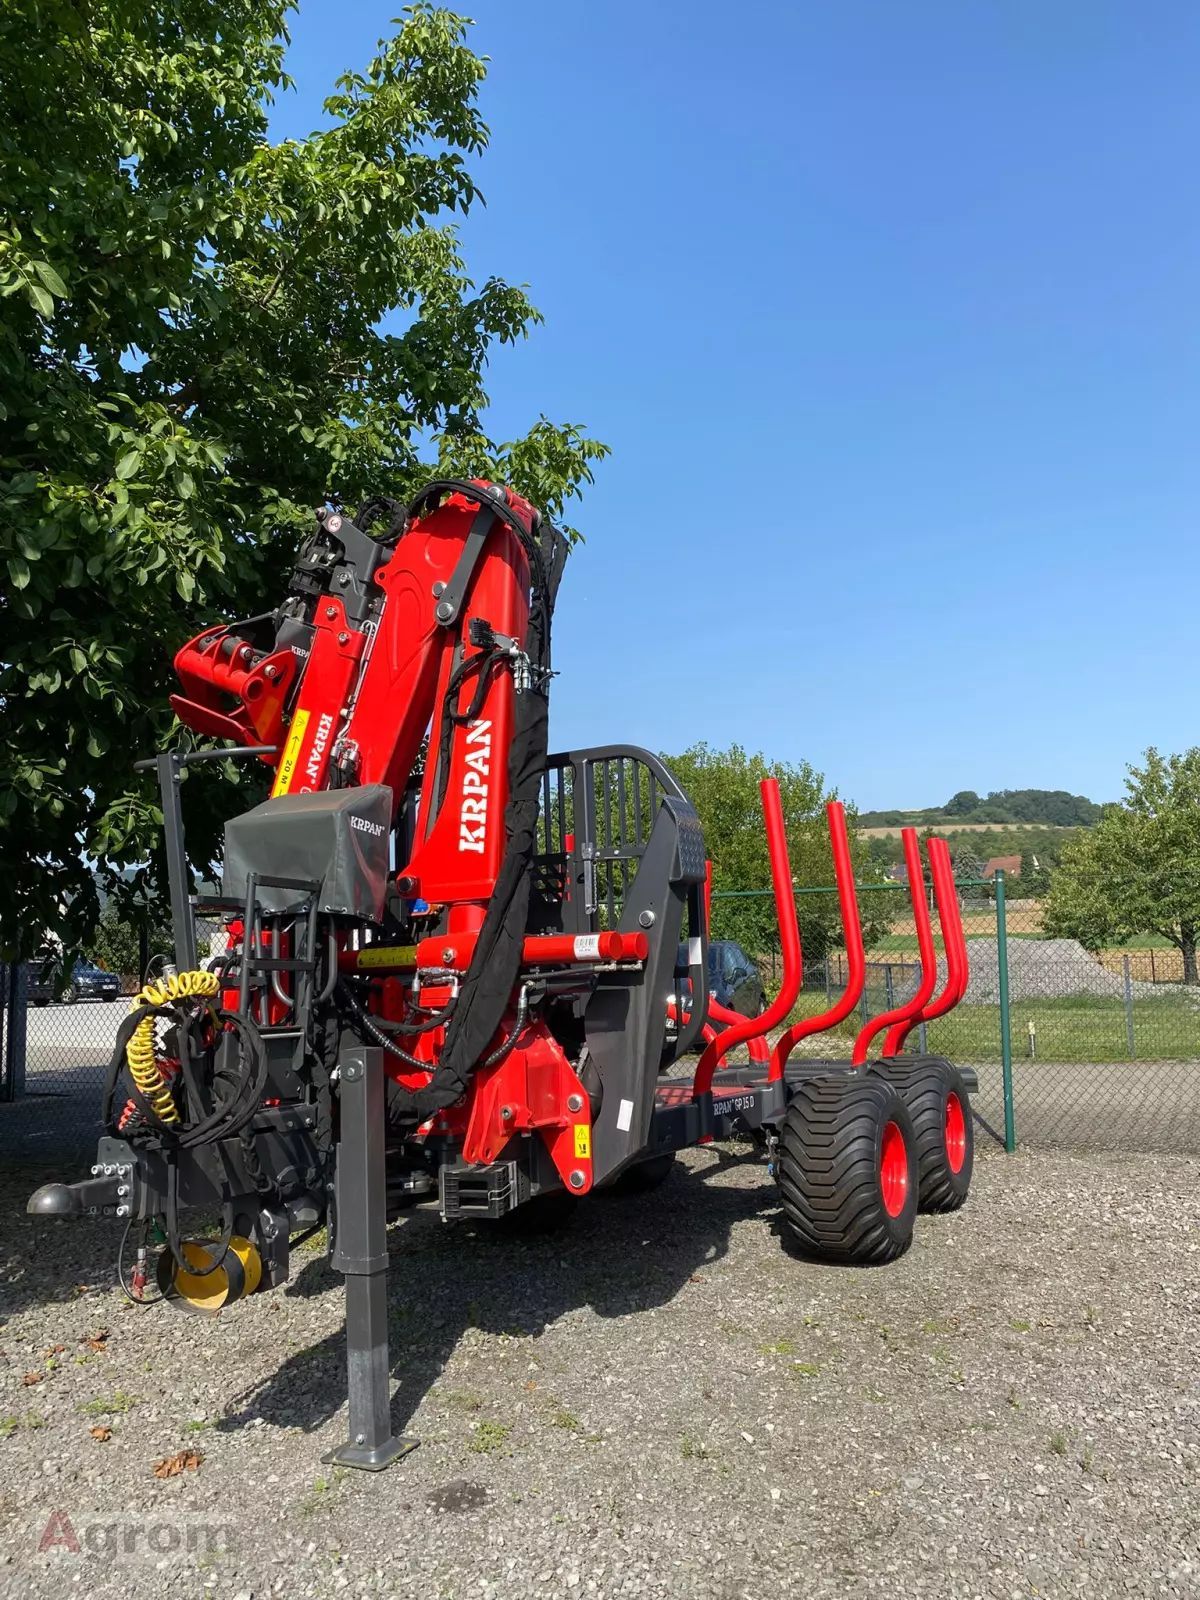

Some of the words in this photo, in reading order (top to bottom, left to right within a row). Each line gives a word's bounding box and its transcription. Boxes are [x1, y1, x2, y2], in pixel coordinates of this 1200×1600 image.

[291, 645, 310, 658] KRPA
[306, 713, 333, 778] KRPAN
[284, 759, 293, 772] 20
[458, 719, 492, 854] KRPAN
[350, 815, 382, 837] KRPAN
[713, 1101, 732, 1116] RPAN
